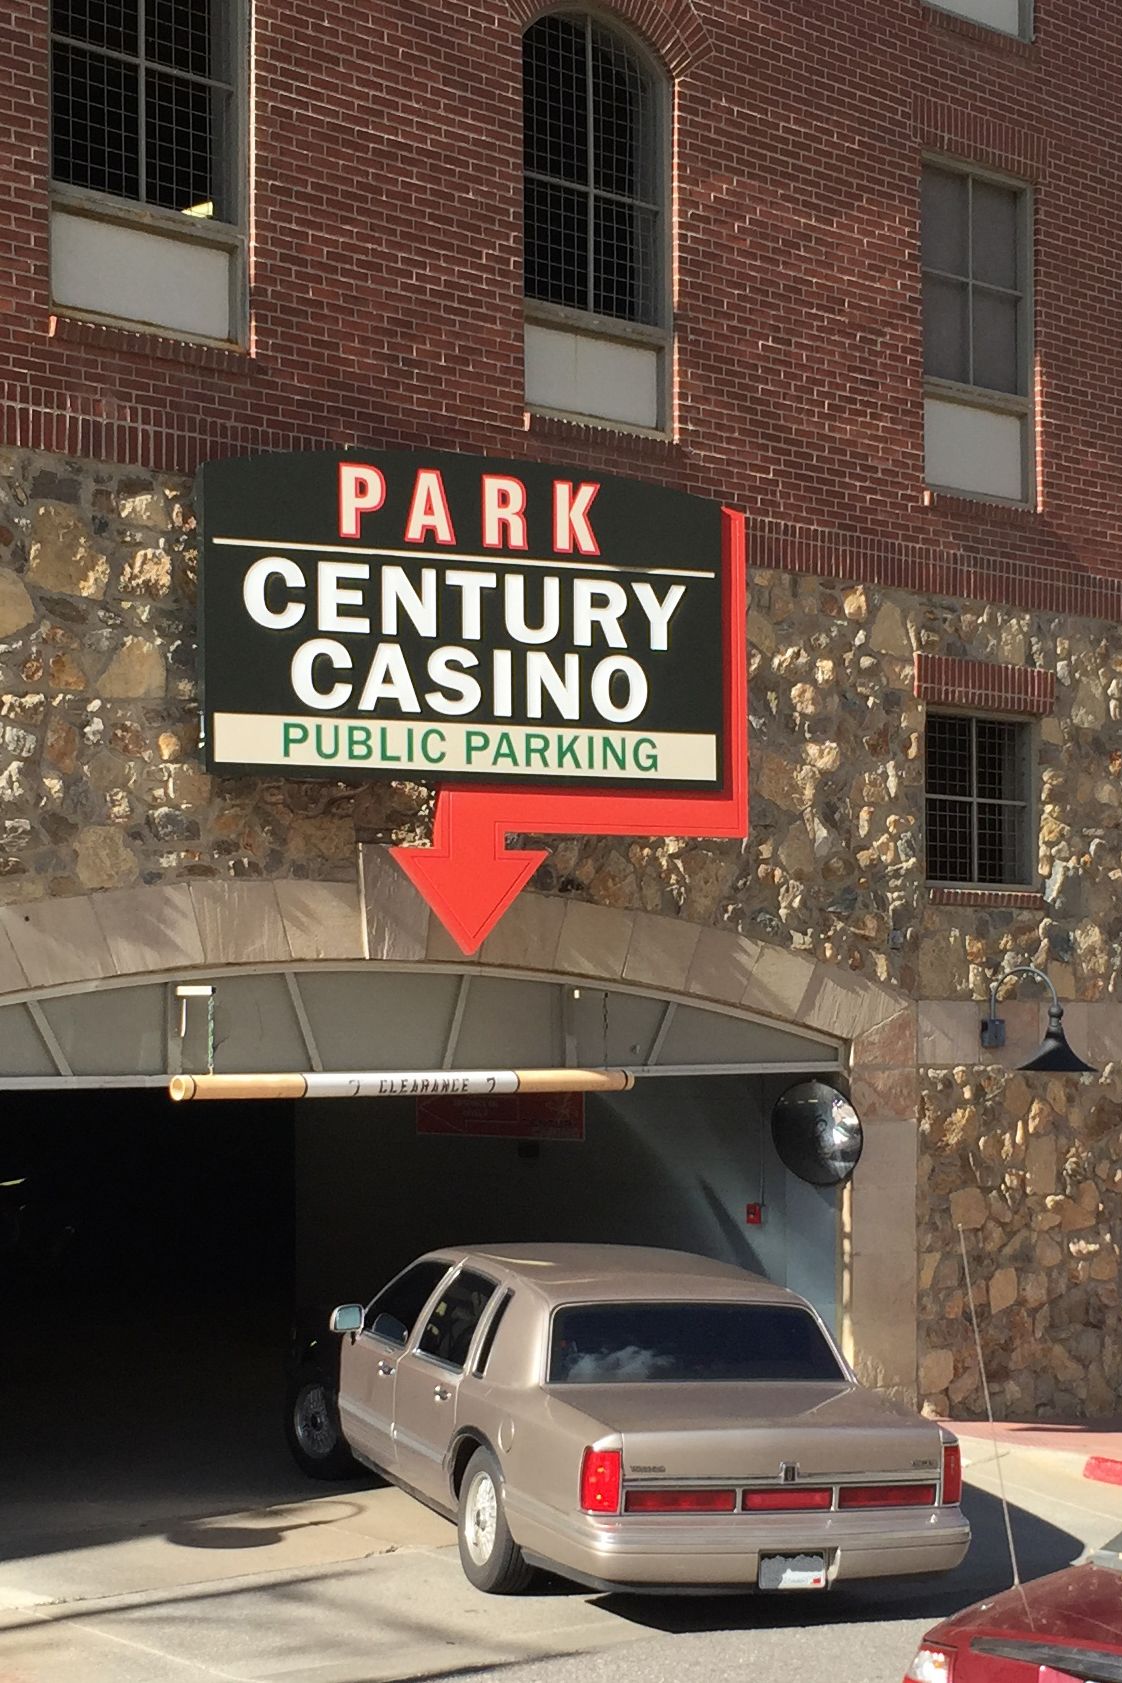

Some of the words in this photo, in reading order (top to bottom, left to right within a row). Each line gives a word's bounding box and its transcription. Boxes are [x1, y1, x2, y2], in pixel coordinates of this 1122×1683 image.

[338, 461, 601, 557] PARK
[243, 556, 687, 651] CENTURY
[290, 638, 648, 723] CASINO
[281, 720, 447, 764] PUBLIC
[464, 728, 659, 772] PARKING
[378, 1078, 470, 1094] CLEARANCE
